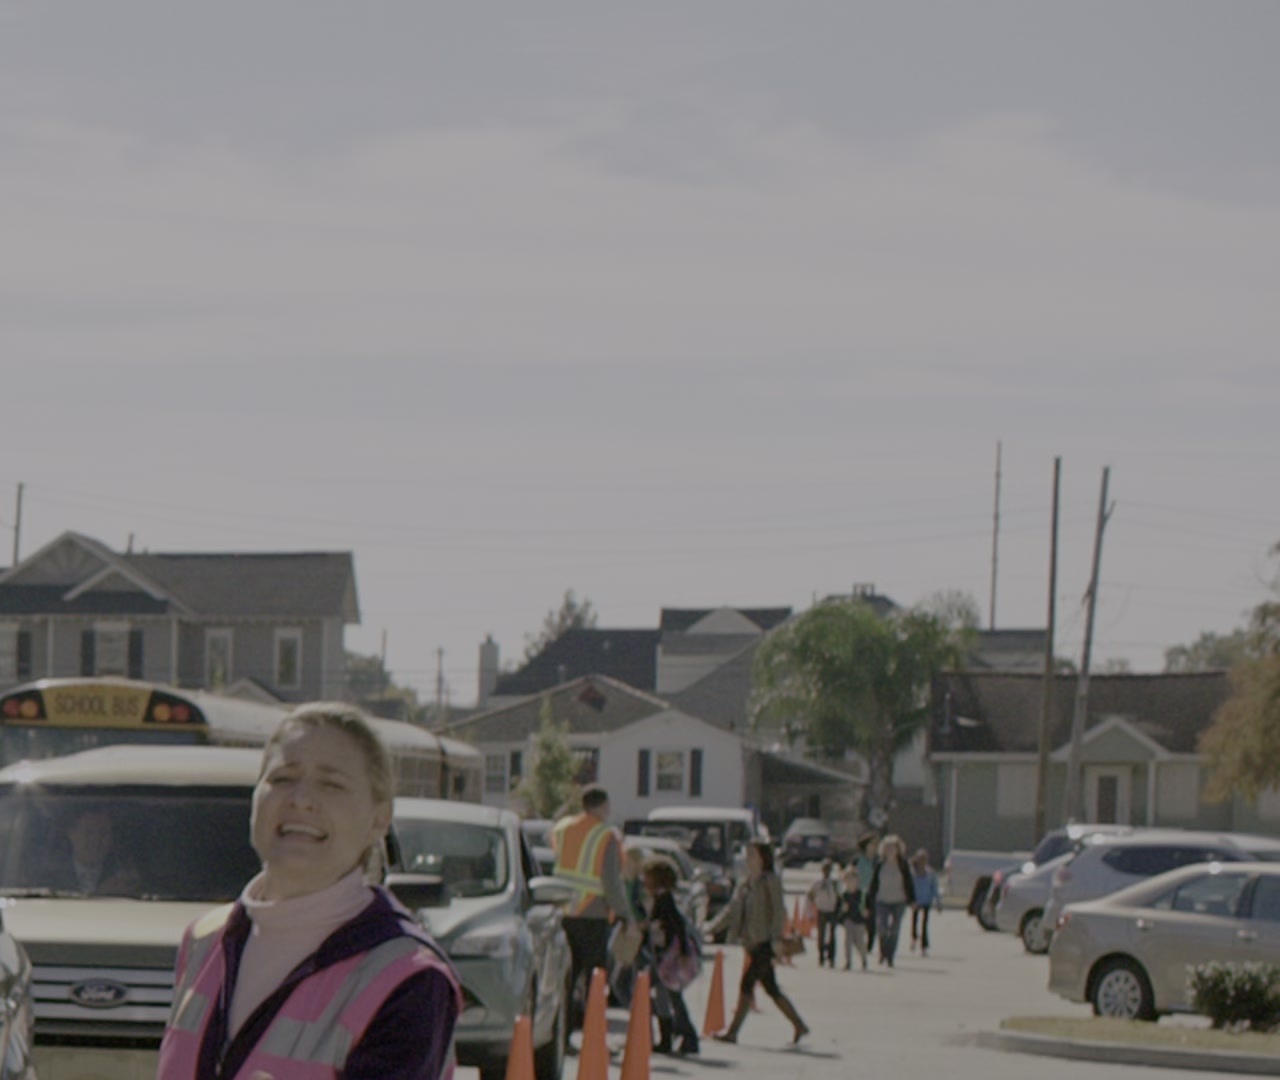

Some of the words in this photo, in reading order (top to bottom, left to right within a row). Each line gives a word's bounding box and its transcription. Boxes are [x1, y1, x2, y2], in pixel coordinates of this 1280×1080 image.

[55, 693, 107, 715] SCHOOL
[112, 695, 139, 716] BUS
[77, 984, 116, 1002] Ford
